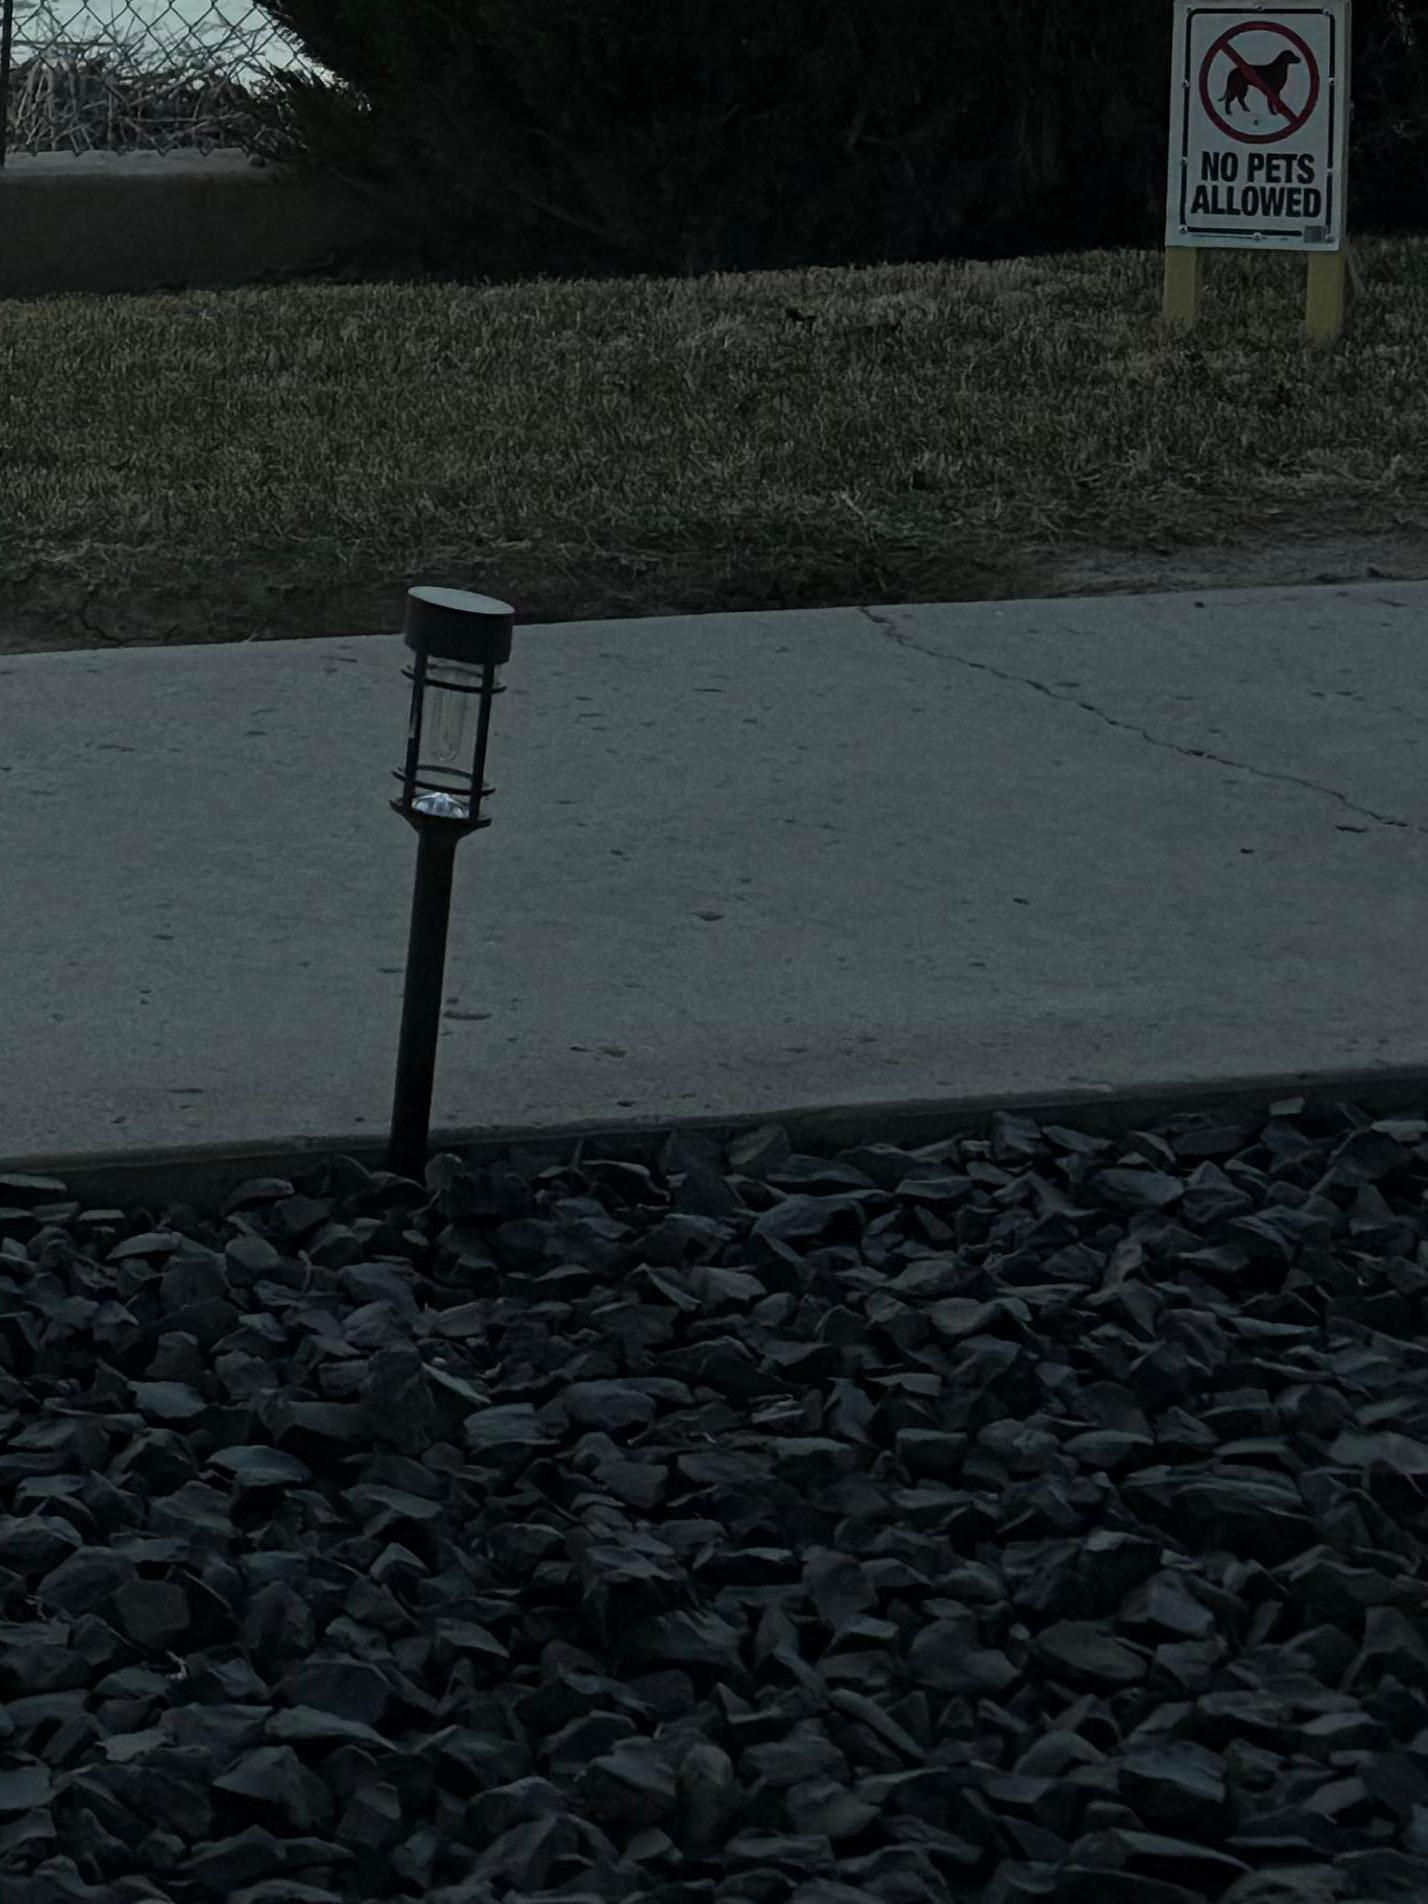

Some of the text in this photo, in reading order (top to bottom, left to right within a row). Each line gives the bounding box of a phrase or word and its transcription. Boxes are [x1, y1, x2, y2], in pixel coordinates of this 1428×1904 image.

[1201, 151, 1315, 184] NO PETS
[1191, 185, 1321, 218] ALLOWED
